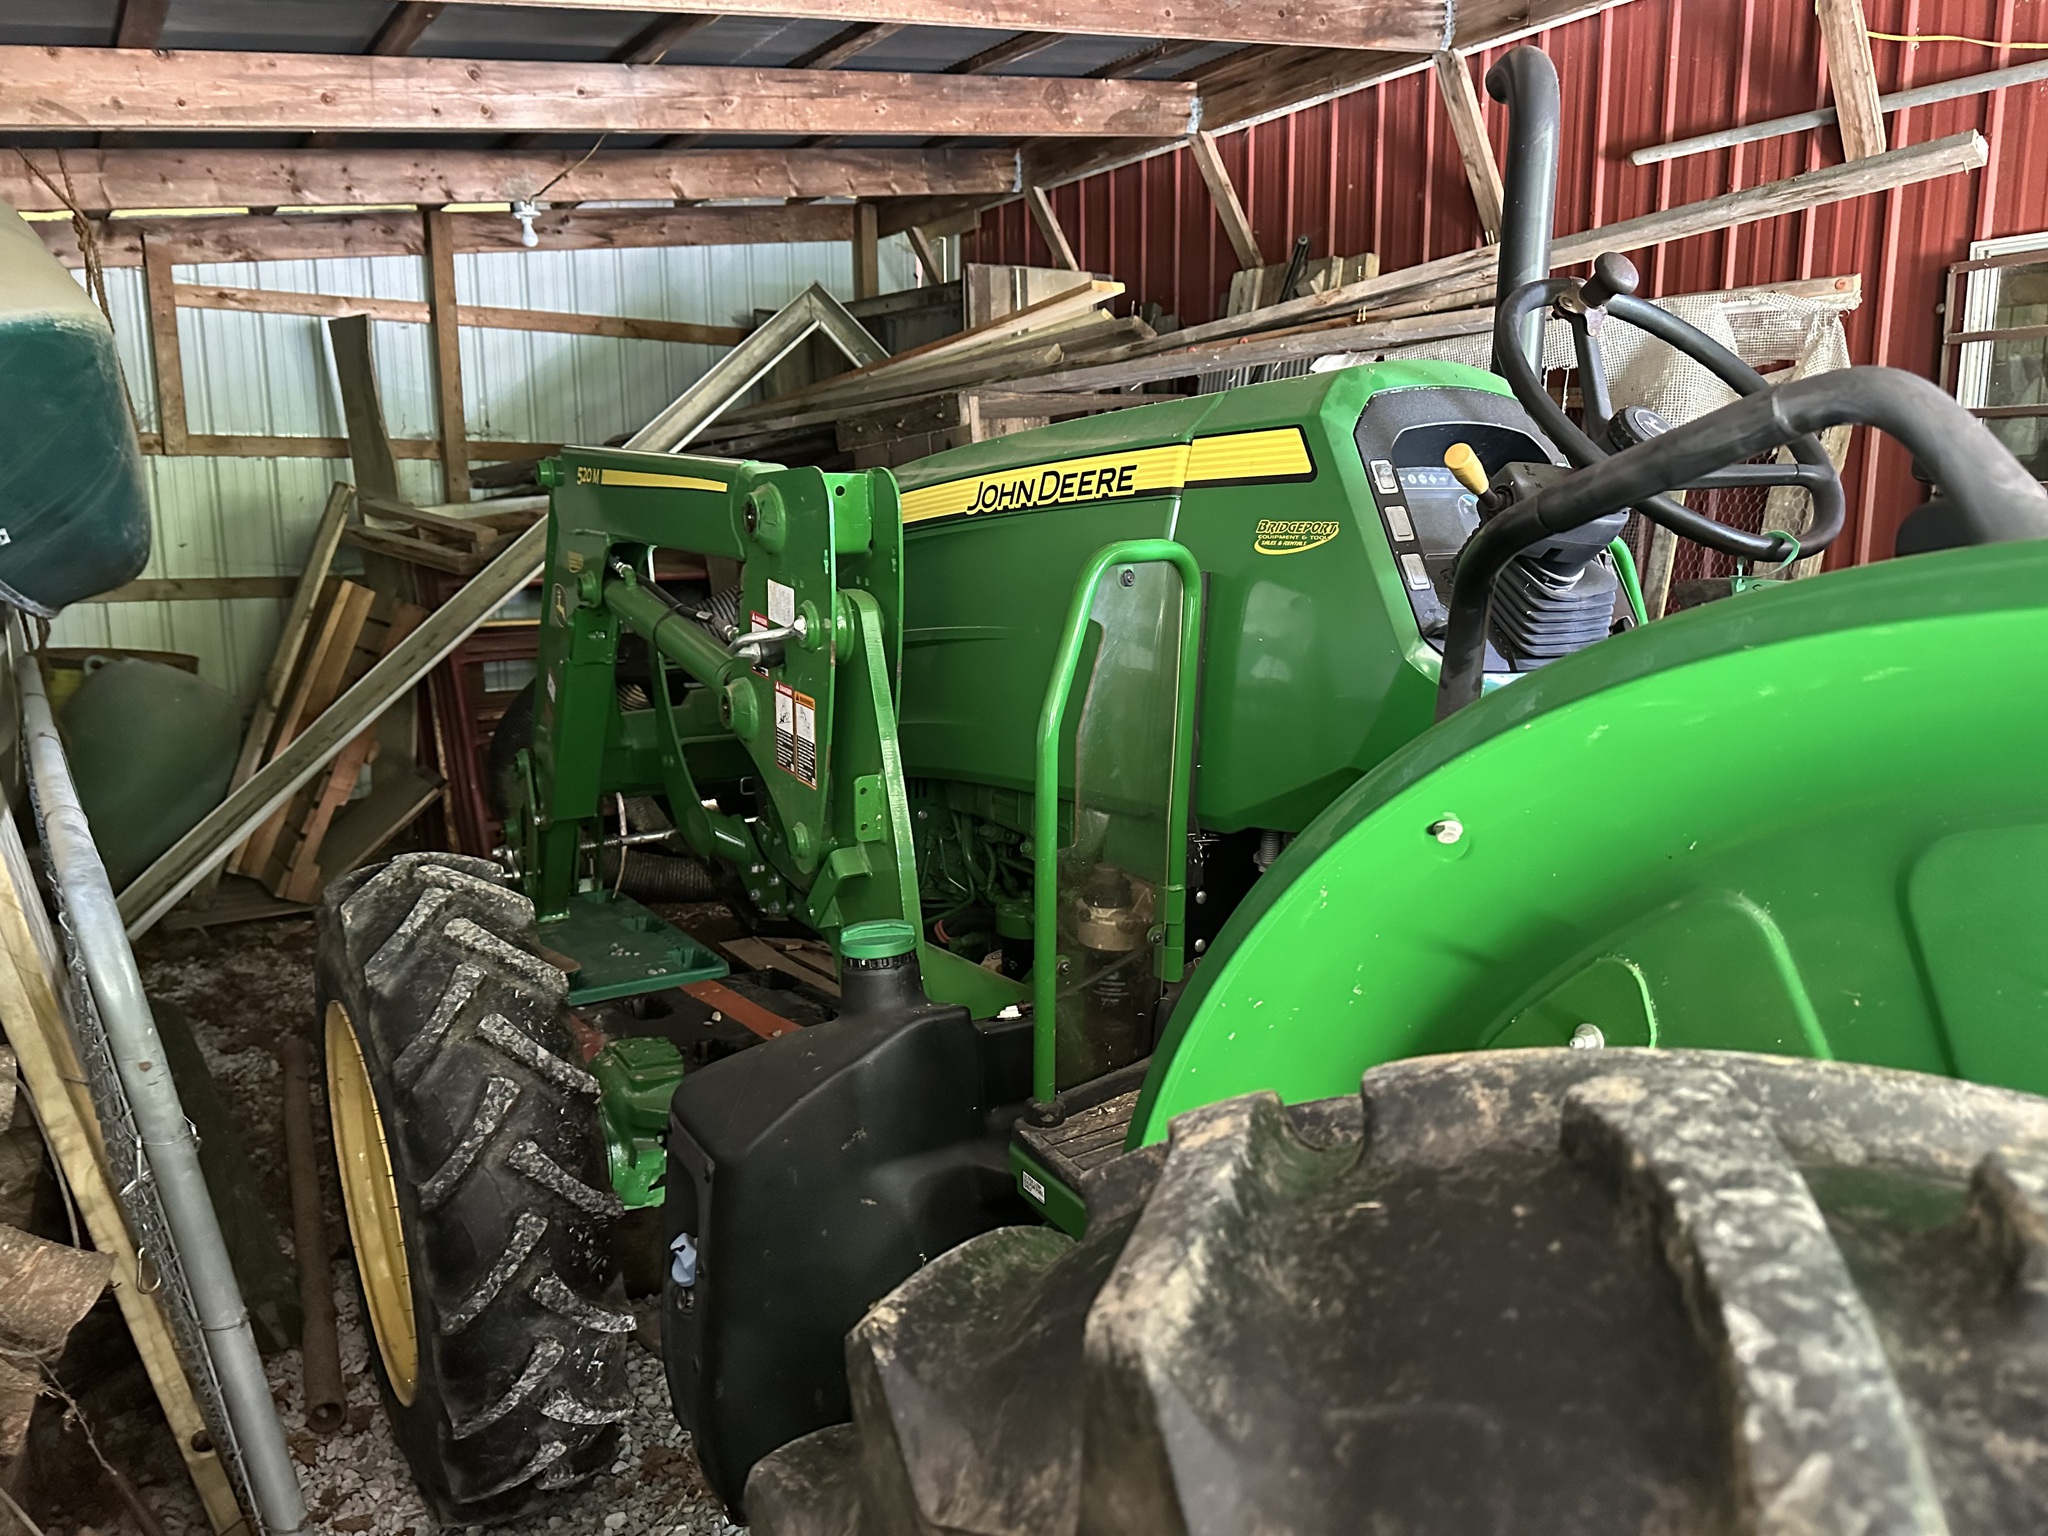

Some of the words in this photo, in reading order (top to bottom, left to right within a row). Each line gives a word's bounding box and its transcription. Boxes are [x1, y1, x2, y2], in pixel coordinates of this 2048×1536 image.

[966, 478, 1036, 511] JOHN
[1037, 464, 1138, 502] DEERE
[1256, 520, 1339, 535] BRIDGEPORT
